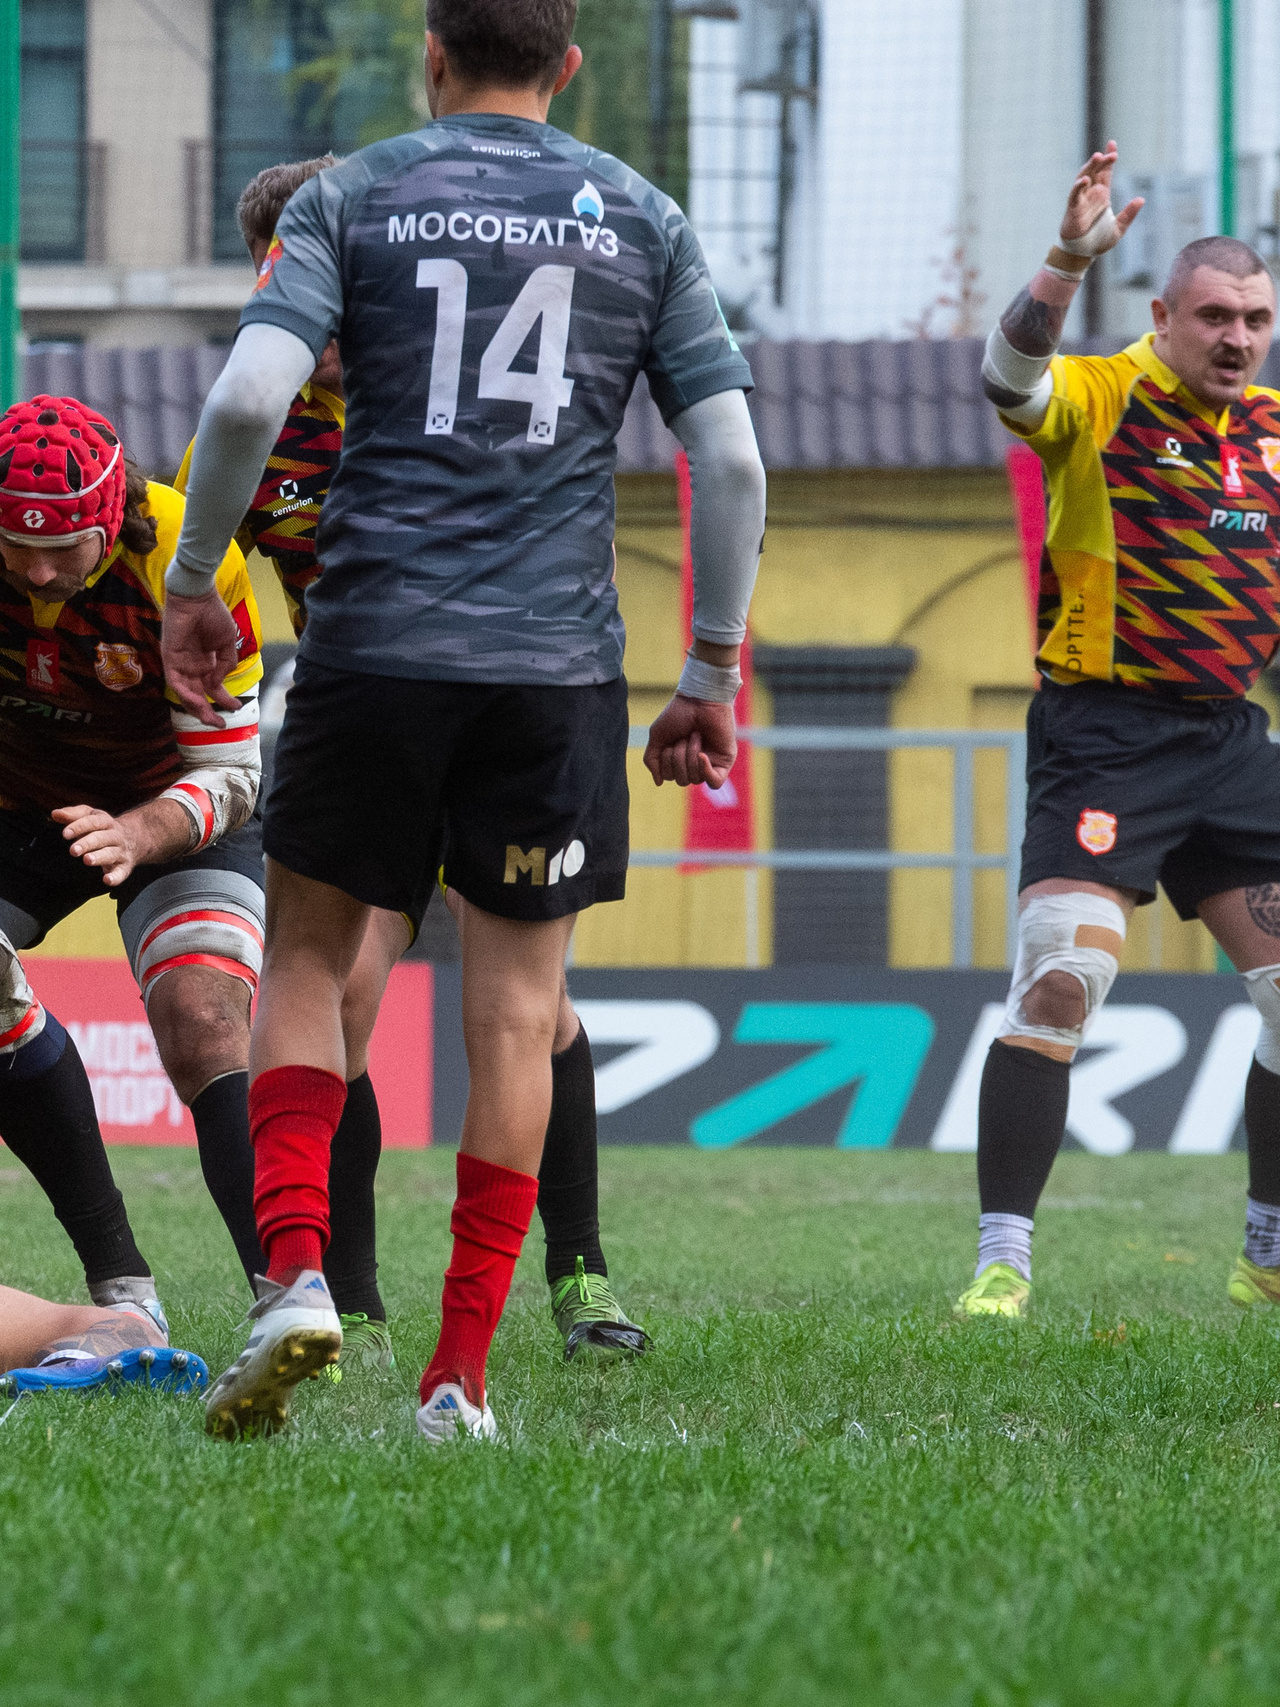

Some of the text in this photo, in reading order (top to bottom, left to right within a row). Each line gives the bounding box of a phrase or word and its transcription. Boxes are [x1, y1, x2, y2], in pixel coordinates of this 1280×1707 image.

[471, 145, 541, 159] centurion
[415, 257, 576, 446] 14
[272, 497, 314, 518] centurion
[1209, 508, 1268, 532] PARI
[0, 695, 92, 725] PARI
[67, 1022, 167, 1072] МОС
[91, 1074, 183, 1127] ПОРТ
